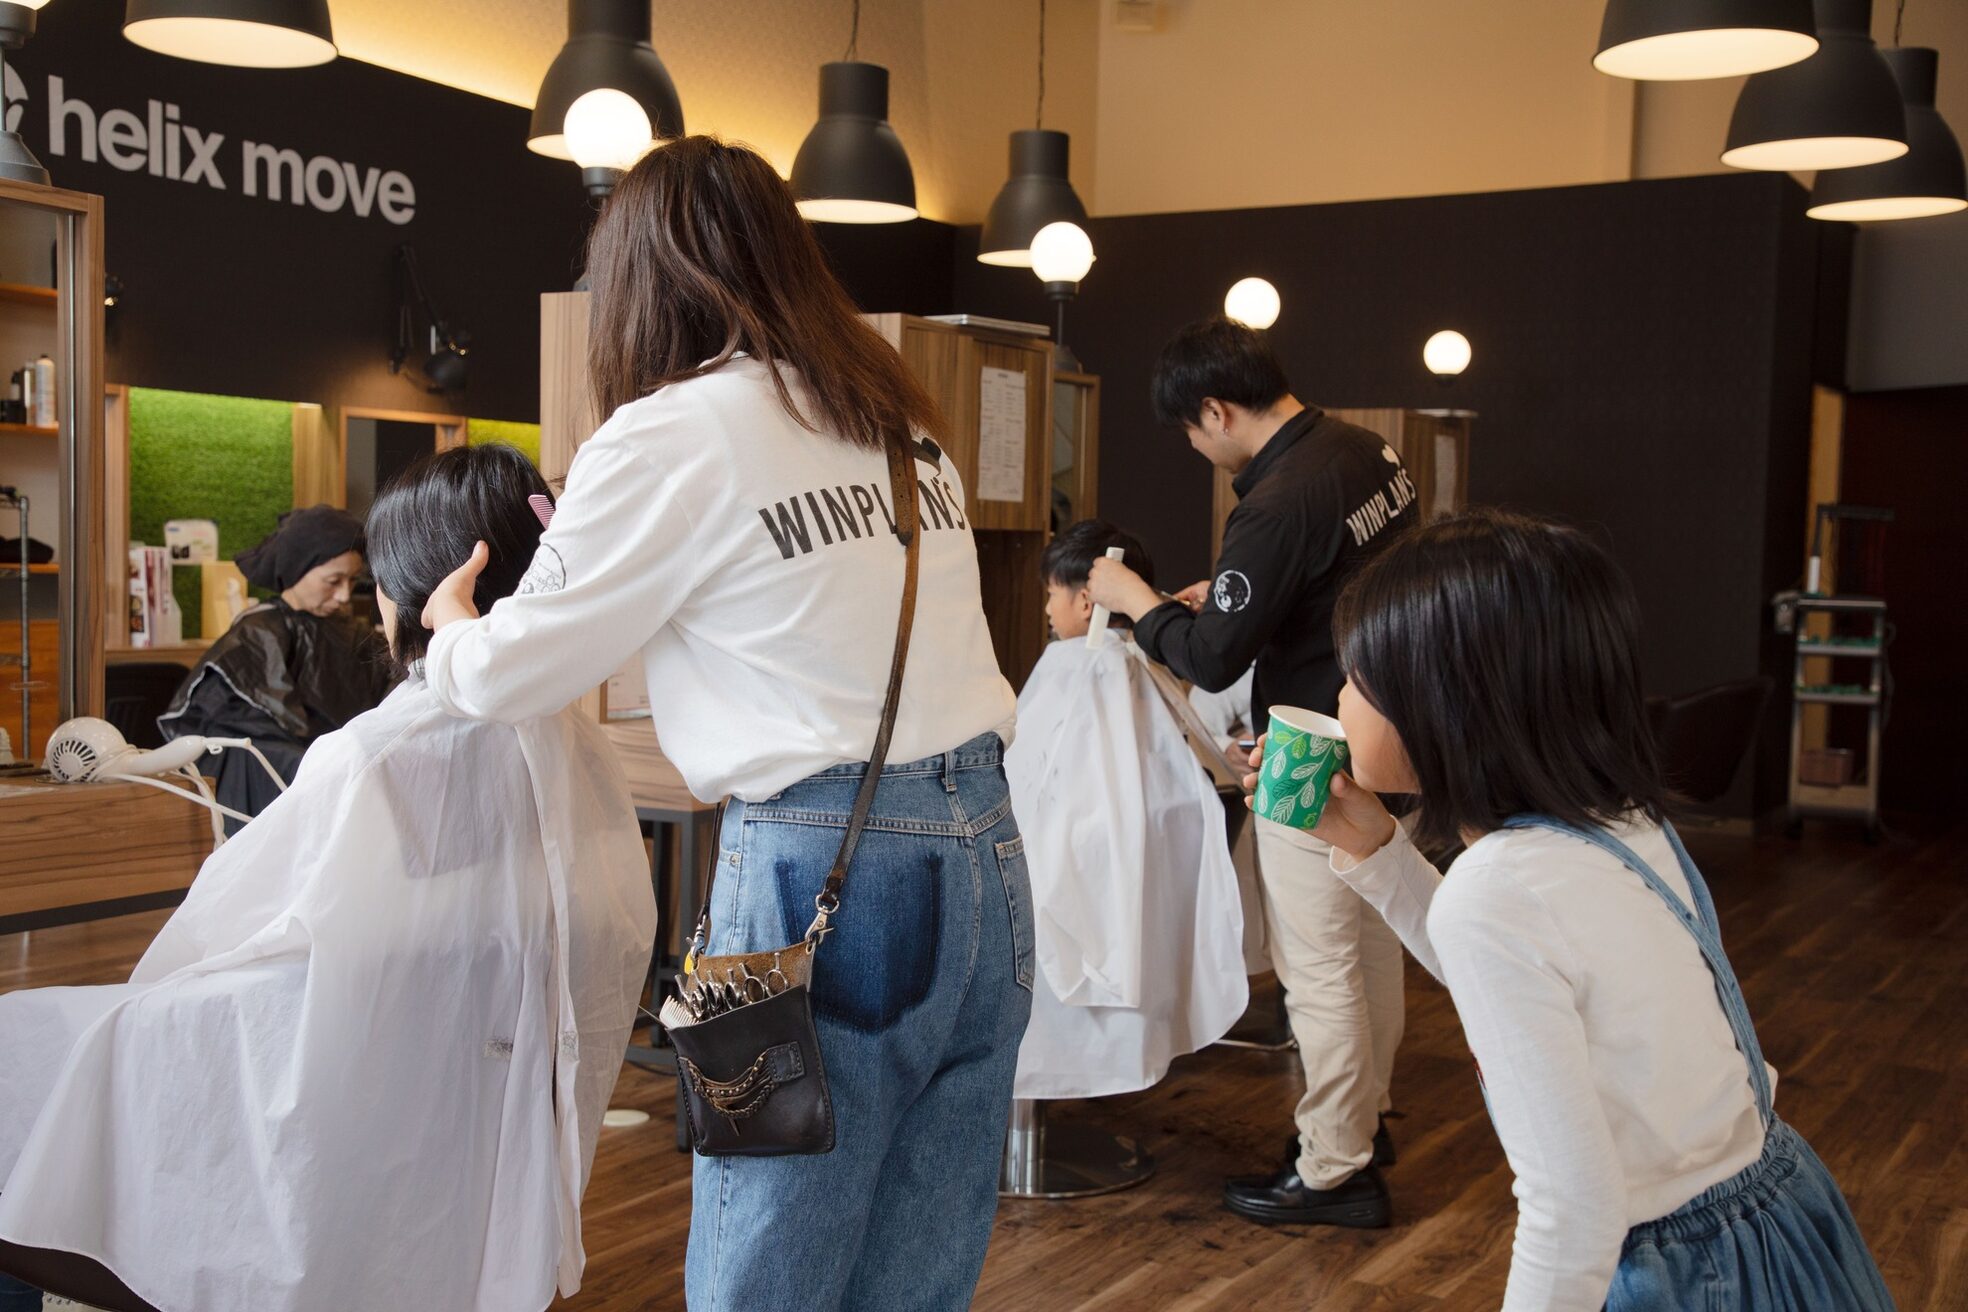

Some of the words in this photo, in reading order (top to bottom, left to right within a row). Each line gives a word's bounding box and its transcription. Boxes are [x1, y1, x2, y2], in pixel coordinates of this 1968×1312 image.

[48, 74, 226, 190] helix
[242, 140, 417, 225] move
[758, 478, 966, 560] WINPLNS
[1346, 468, 1416, 547] WINPLANS
